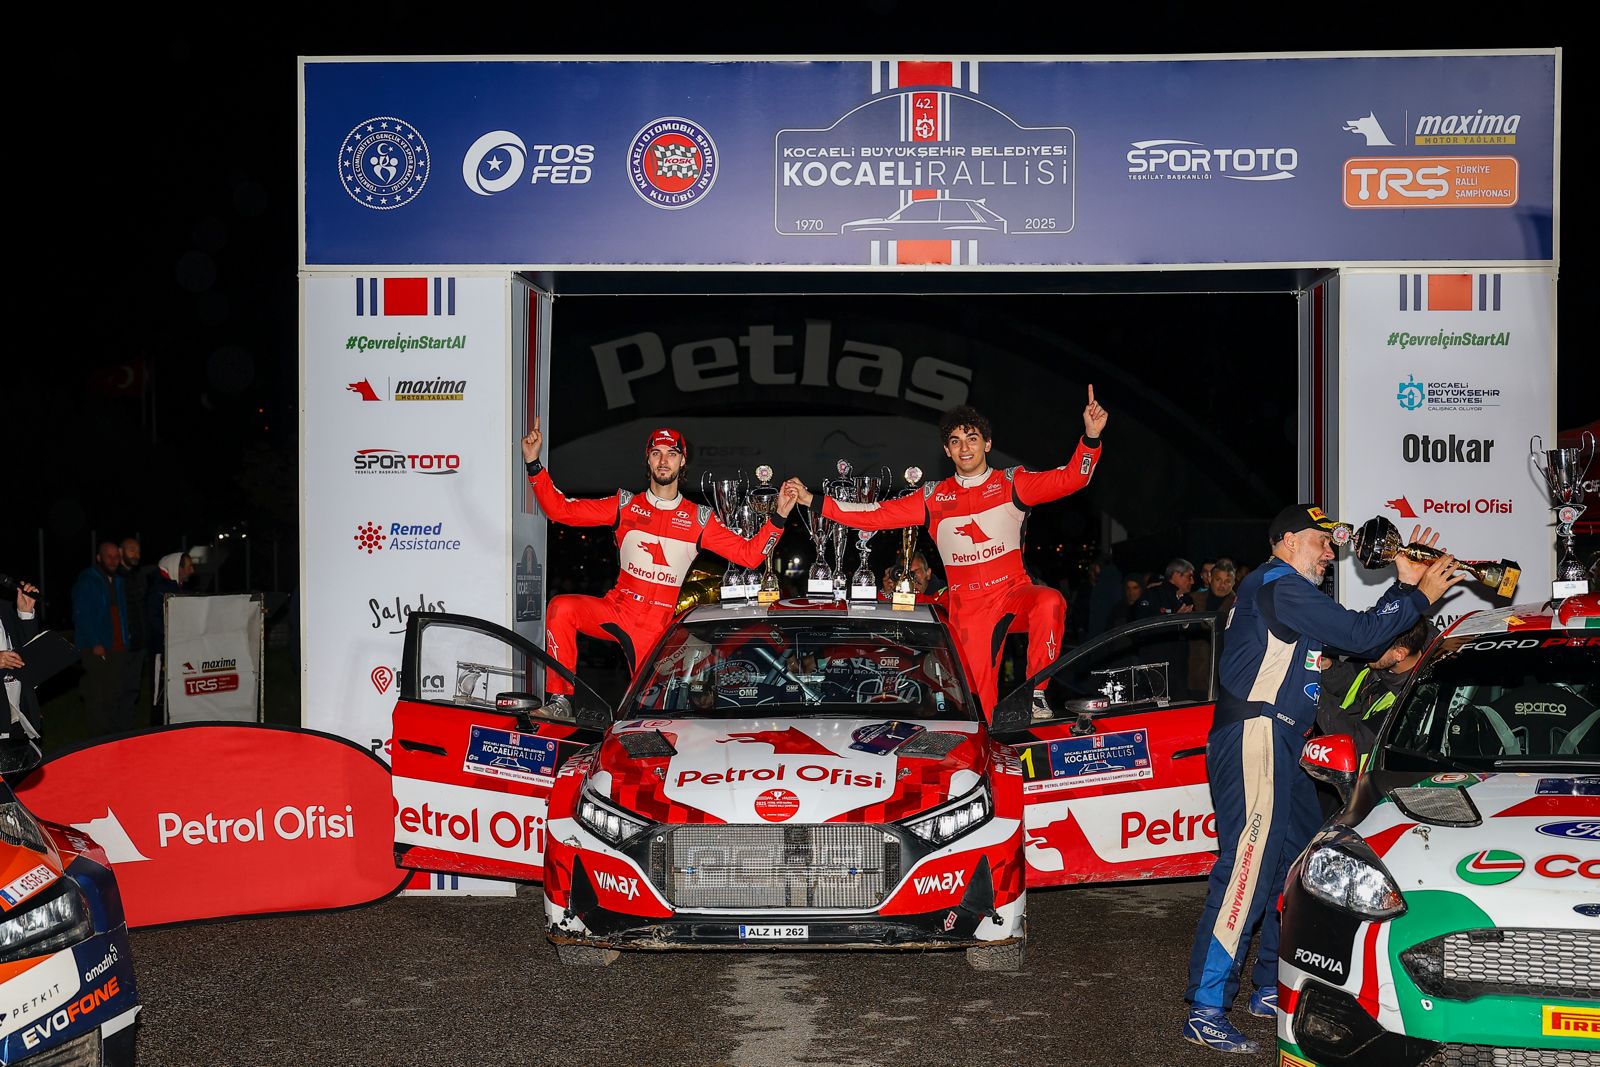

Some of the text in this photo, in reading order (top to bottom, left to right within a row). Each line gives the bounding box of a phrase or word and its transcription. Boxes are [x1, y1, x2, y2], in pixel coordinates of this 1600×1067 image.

[1416, 109, 1520, 135] maxima
[1424, 136, 1458, 144] MOTOR
[533, 144, 595, 164] TOS
[531, 165, 592, 184] FED
[1456, 164, 1490, 174] TÜRKİYE
[1350, 165, 1451, 200] TRS
[1456, 178, 1478, 186] RALLİ
[1455, 188, 1511, 199] ŞAMPİYONASI
[795, 220, 824, 231] 1970
[1024, 218, 1056, 230] 2025
[590, 319, 972, 412] Petlas
[396, 376, 466, 394] maxima
[1402, 434, 1494, 463] Otokar
[1424, 499, 1512, 514] Petrol Ofisi
[390, 522, 442, 536] Remed
[390, 537, 461, 550] Assistance
[952, 542, 1005, 563] Petrol Ofisi
[628, 562, 678, 584] Petrol Ofisi
[1457, 640, 1540, 652] FORD
[202, 658, 236, 669] maxima
[880, 658, 900, 666] OMP
[186, 678, 218, 693] TRS
[738, 688, 758, 697] OMP
[1514, 702, 1566, 714] sparco
[1302, 742, 1332, 764] NGK
[1020, 748, 1036, 778] 1
[676, 764, 882, 788] Petrol Ofisi
[158, 805, 354, 847] Petrol Ofisi
[1226, 812, 1262, 932] FORD PERFORMANCE
[748, 928, 804, 936] ALZ H 262
[1294, 948, 1344, 975] FORVIA
[13, 983, 60, 1019] PETKIT
[22, 976, 120, 1050] EVOFONE
